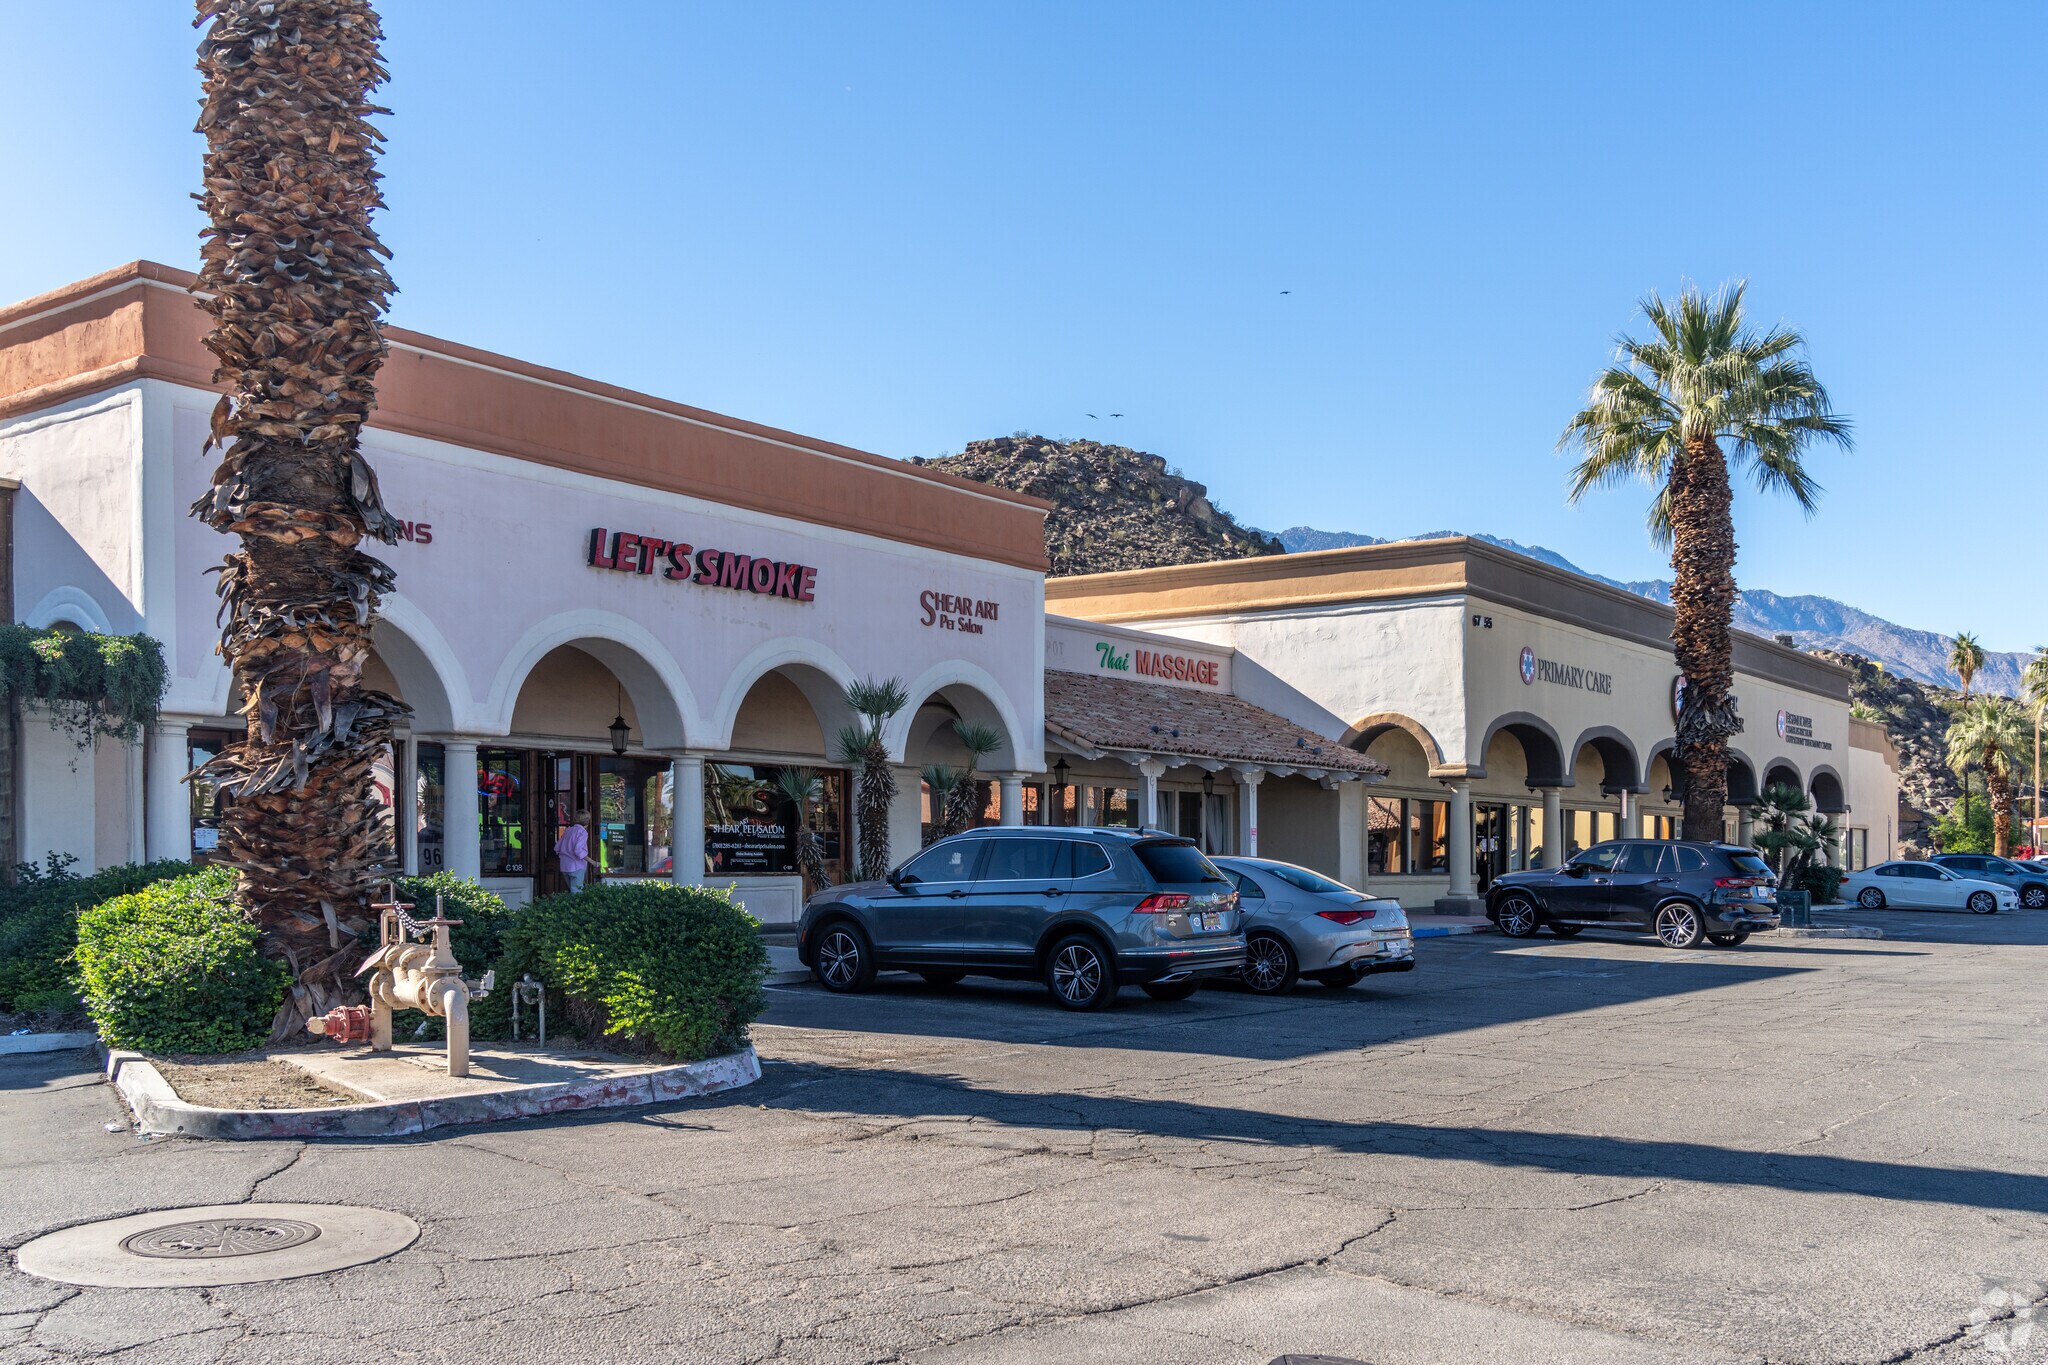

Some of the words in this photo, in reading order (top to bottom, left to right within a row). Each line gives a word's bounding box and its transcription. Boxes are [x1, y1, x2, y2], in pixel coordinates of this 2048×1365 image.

[588, 527, 694, 581] LET'S
[692, 548, 818, 602] SMOKE
[920, 590, 973, 626] SHEAR
[975, 599, 1000, 621] ART
[1096, 642, 1130, 672] Thai
[1135, 649, 1219, 686] MASSAGE
[1537, 658, 1585, 690] PRIMARY
[1585, 669, 1612, 696] CARE
[477, 769, 516, 797] OPEN
[713, 824, 740, 833] SHEAR
[759, 825, 785, 834] SALON
[423, 848, 442, 866] 96
[506, 864, 511, 872] C
[512, 864, 523, 872] 108
